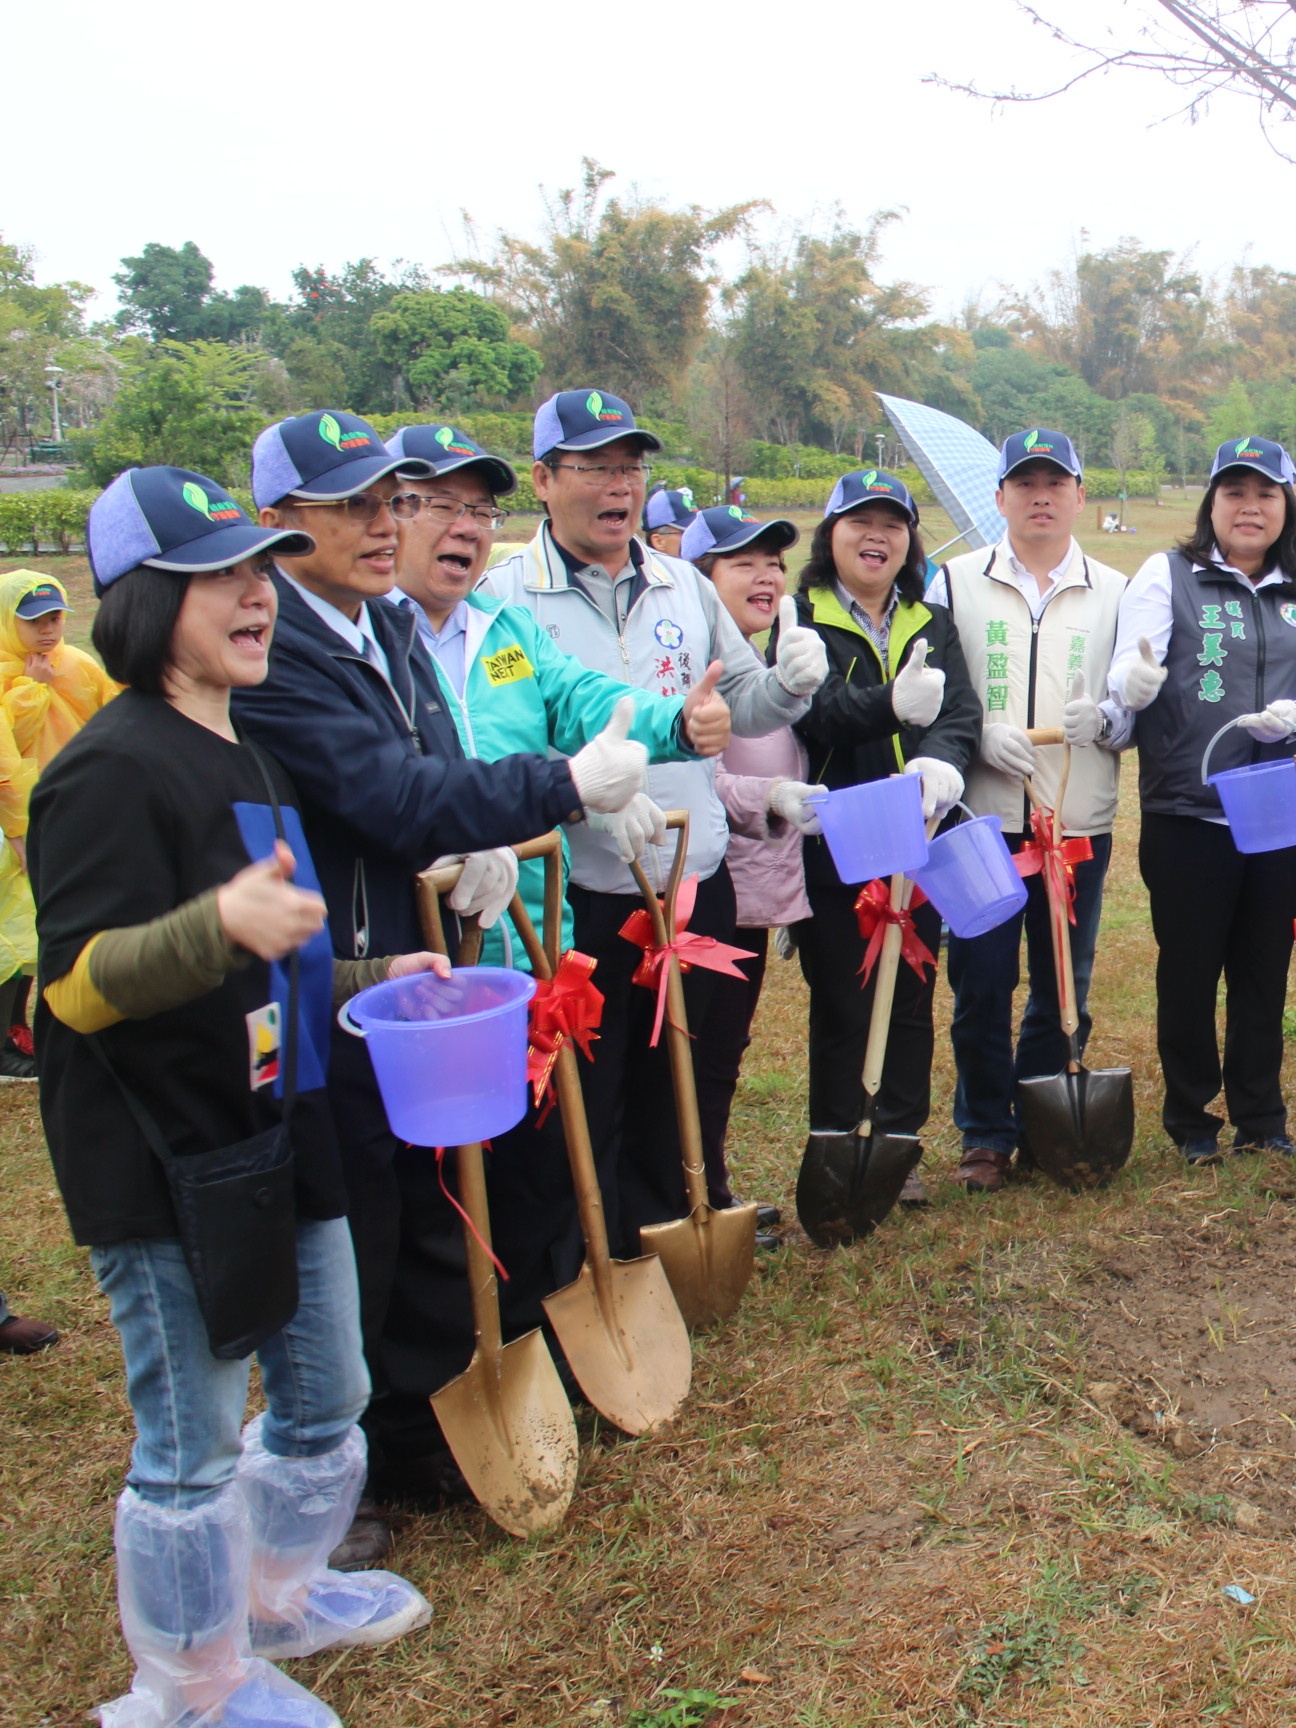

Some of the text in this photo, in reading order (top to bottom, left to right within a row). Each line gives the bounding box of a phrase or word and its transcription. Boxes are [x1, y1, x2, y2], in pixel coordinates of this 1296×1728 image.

[1225, 600, 1246, 640] 議員
[485, 648, 525, 671] TAIWAN
[985, 619, 1009, 712] 黃盈智
[1197, 604, 1228, 703] 王美惠
